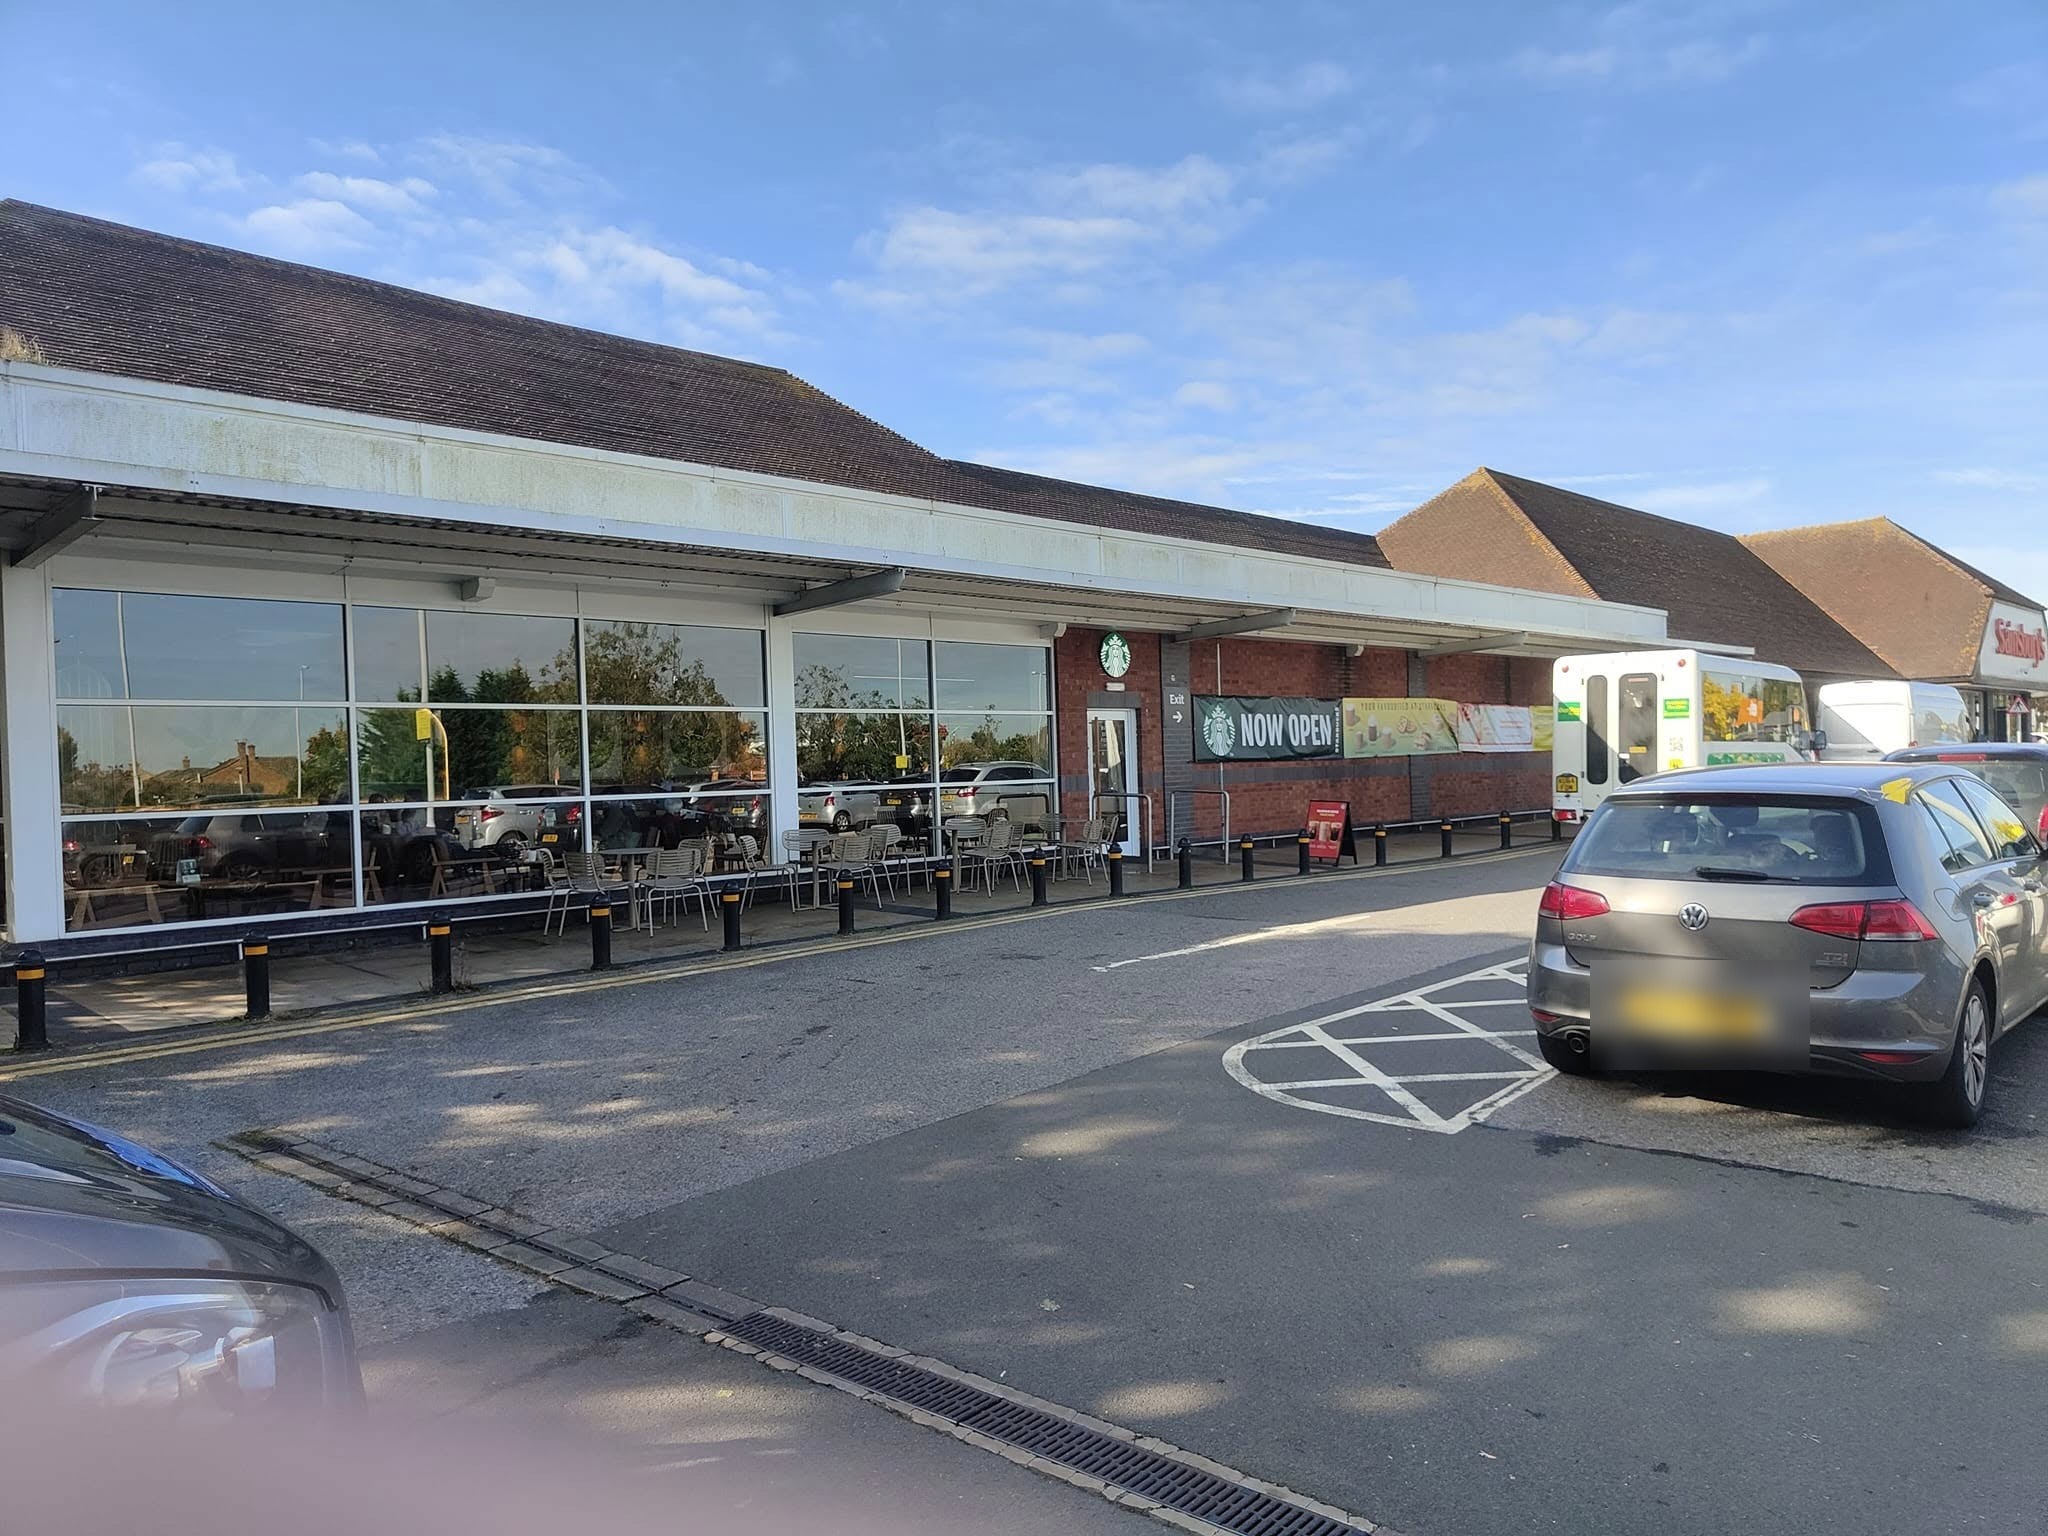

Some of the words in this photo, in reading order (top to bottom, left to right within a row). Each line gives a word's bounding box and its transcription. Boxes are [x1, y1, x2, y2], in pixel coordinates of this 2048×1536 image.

[1995, 618, 2046, 668] Sainsbury's
[1169, 694, 1185, 705] Exit
[1240, 713, 1284, 747] NOW
[1288, 713, 1333, 747] OPEN
[1567, 932, 1597, 942] GOLF
